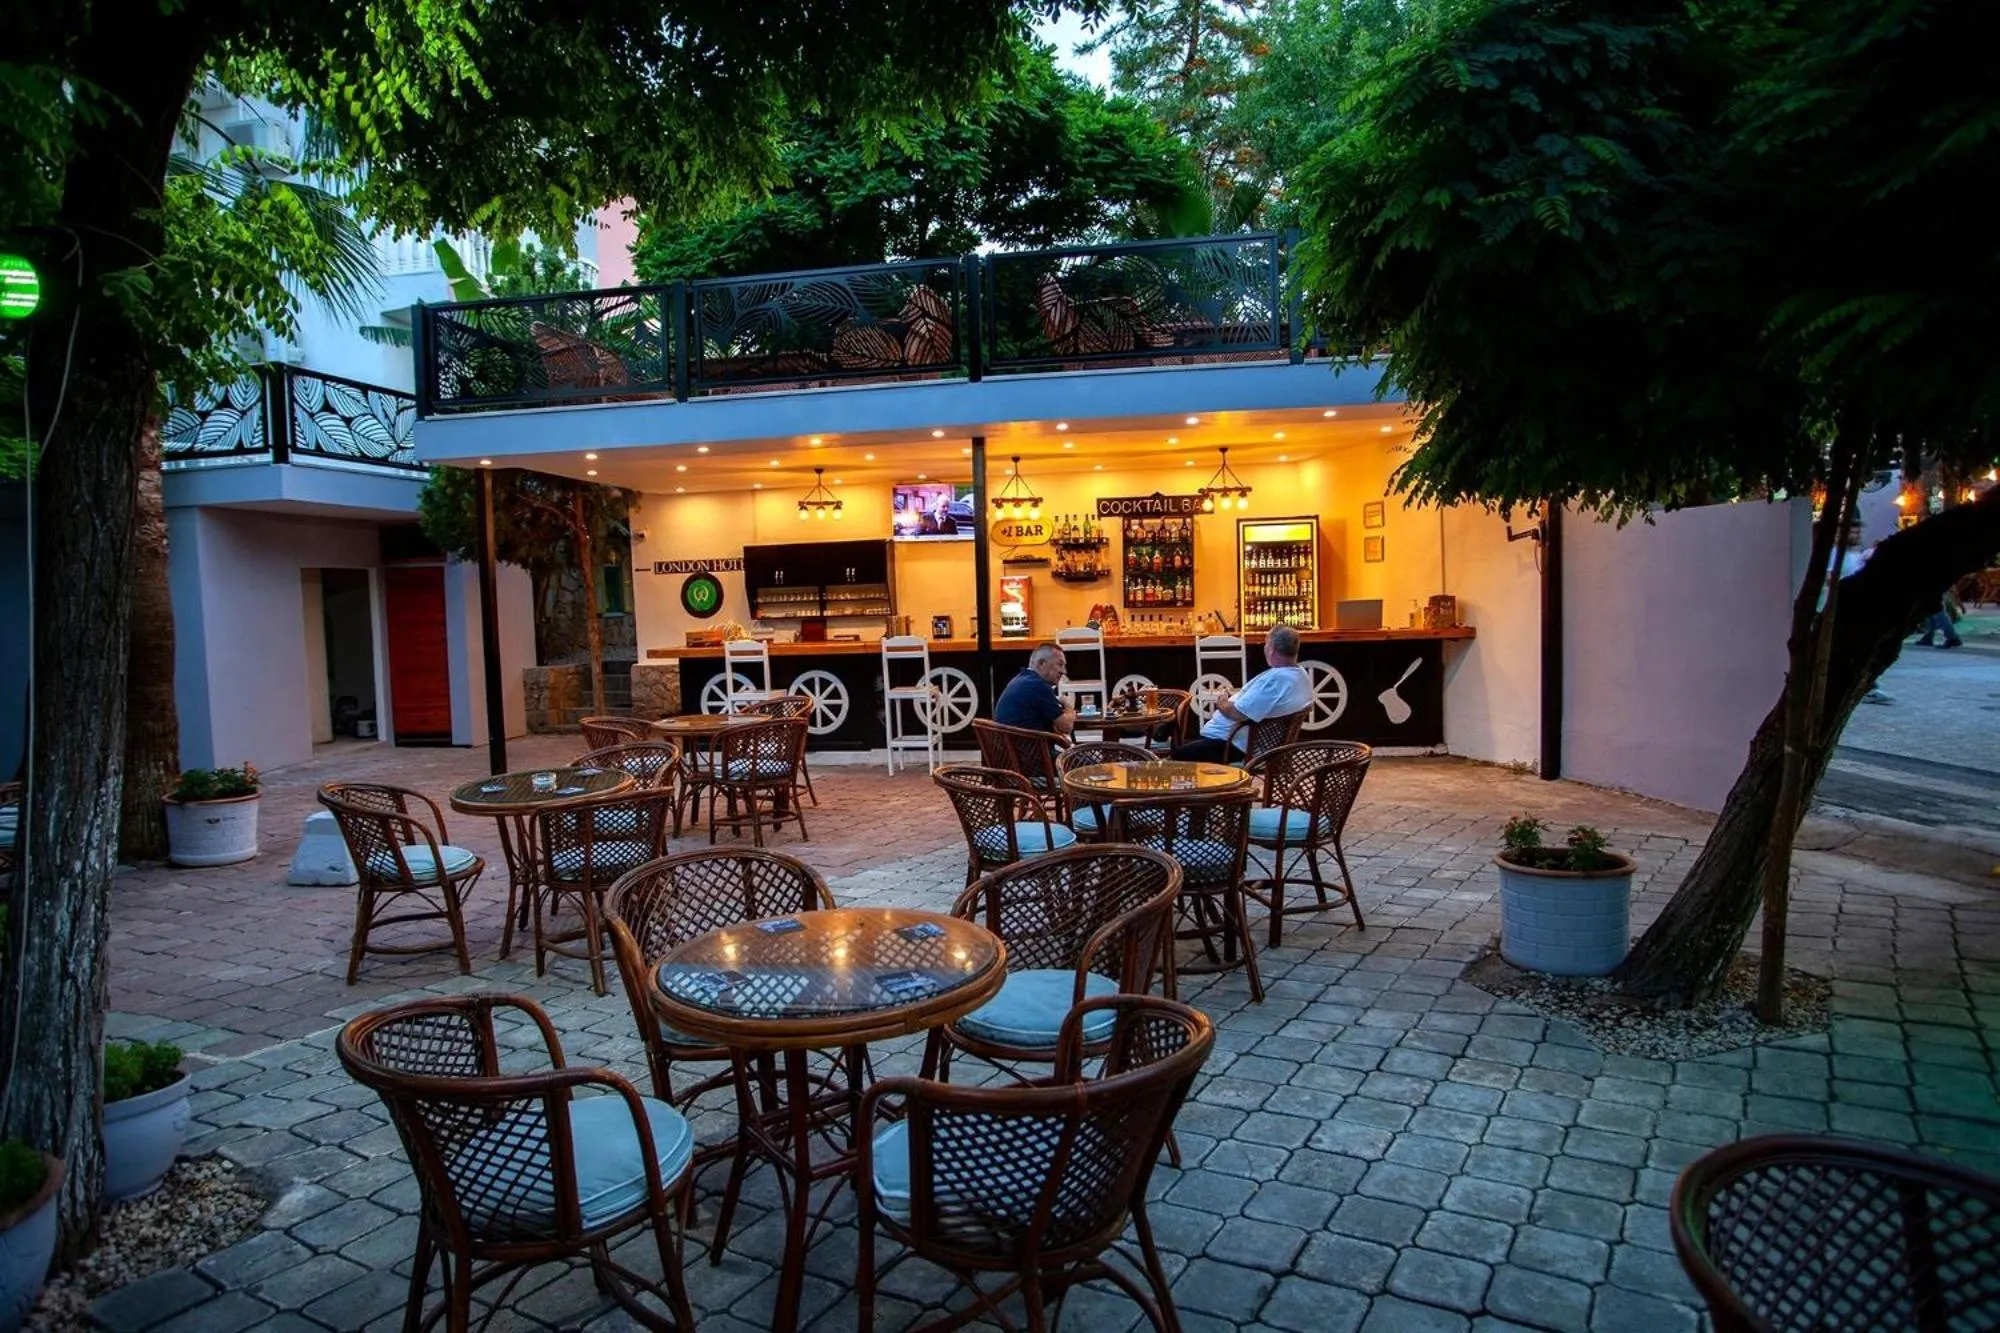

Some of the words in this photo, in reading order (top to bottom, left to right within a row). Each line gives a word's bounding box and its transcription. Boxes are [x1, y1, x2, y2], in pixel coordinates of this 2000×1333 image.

[1099, 498, 1178, 514] COCKTAIL
[1181, 498, 1206, 513] BA
[1015, 524, 1044, 537] BAR
[655, 560, 710, 573] LONDON
